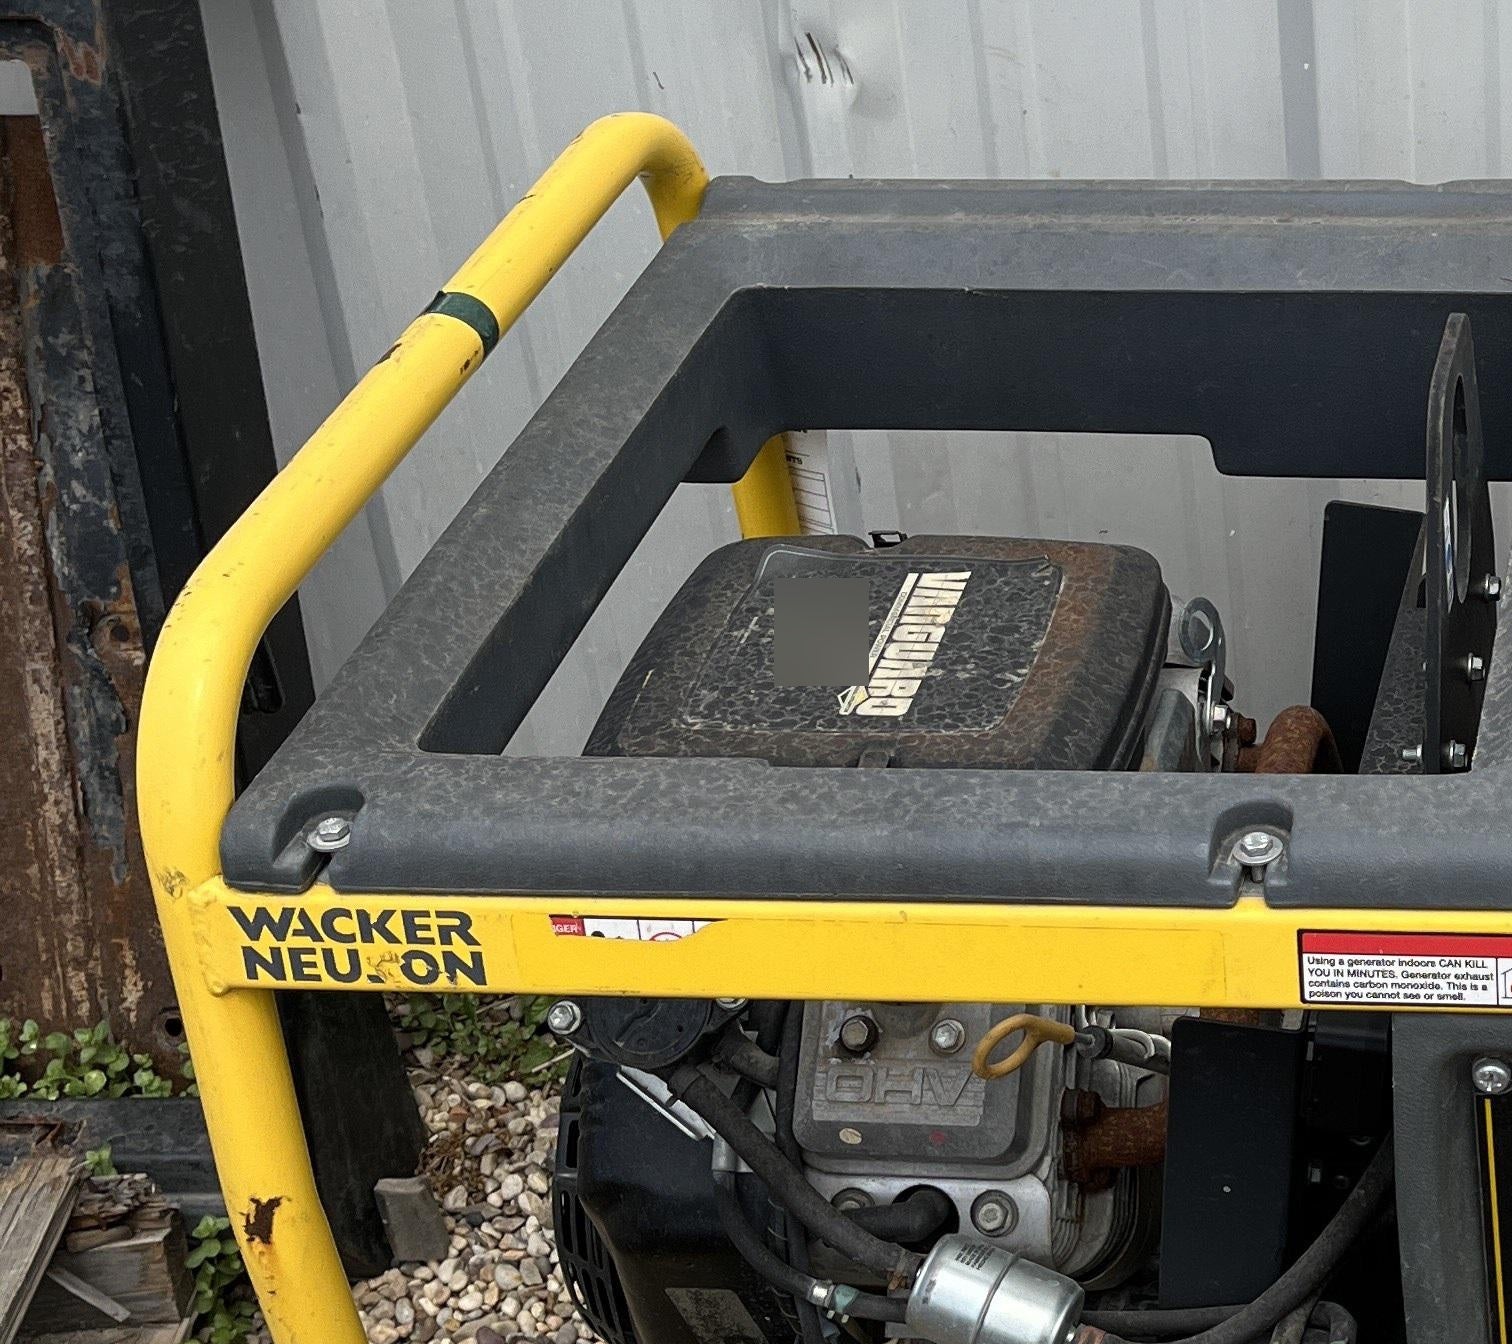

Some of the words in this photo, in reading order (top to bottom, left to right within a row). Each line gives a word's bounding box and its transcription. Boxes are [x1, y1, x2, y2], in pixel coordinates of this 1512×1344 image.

[855, 571, 972, 716] VANGUARD
[227, 905, 481, 946] WACKER
[242, 945, 487, 985] NEUON
[1307, 956, 1335, 967] Using
[1347, 957, 1395, 968] generator
[1397, 958, 1436, 967] indoors
[1438, 959, 1461, 968] CAN
[1464, 959, 1486, 968] KILL
[1308, 968, 1330, 978] YOU
[1333, 969, 1344, 978] IN
[1346, 969, 1396, 979] MINUTES.
[1400, 971, 1450, 980] Generator
[1453, 972, 1493, 981] exhaust
[1308, 979, 1350, 988] contains
[1352, 980, 1388, 989] carbon
[1390, 981, 1441, 990] monoxide.
[1447, 982, 1467, 990] This
[1469, 983, 1478, 991] is
[1308, 989, 1342, 1000] poison
[1344, 992, 1363, 1001] you
[1365, 991, 1400, 999] cannot
[1436, 992, 1464, 1000] smell.
[826, 1065, 974, 1107] OHV
